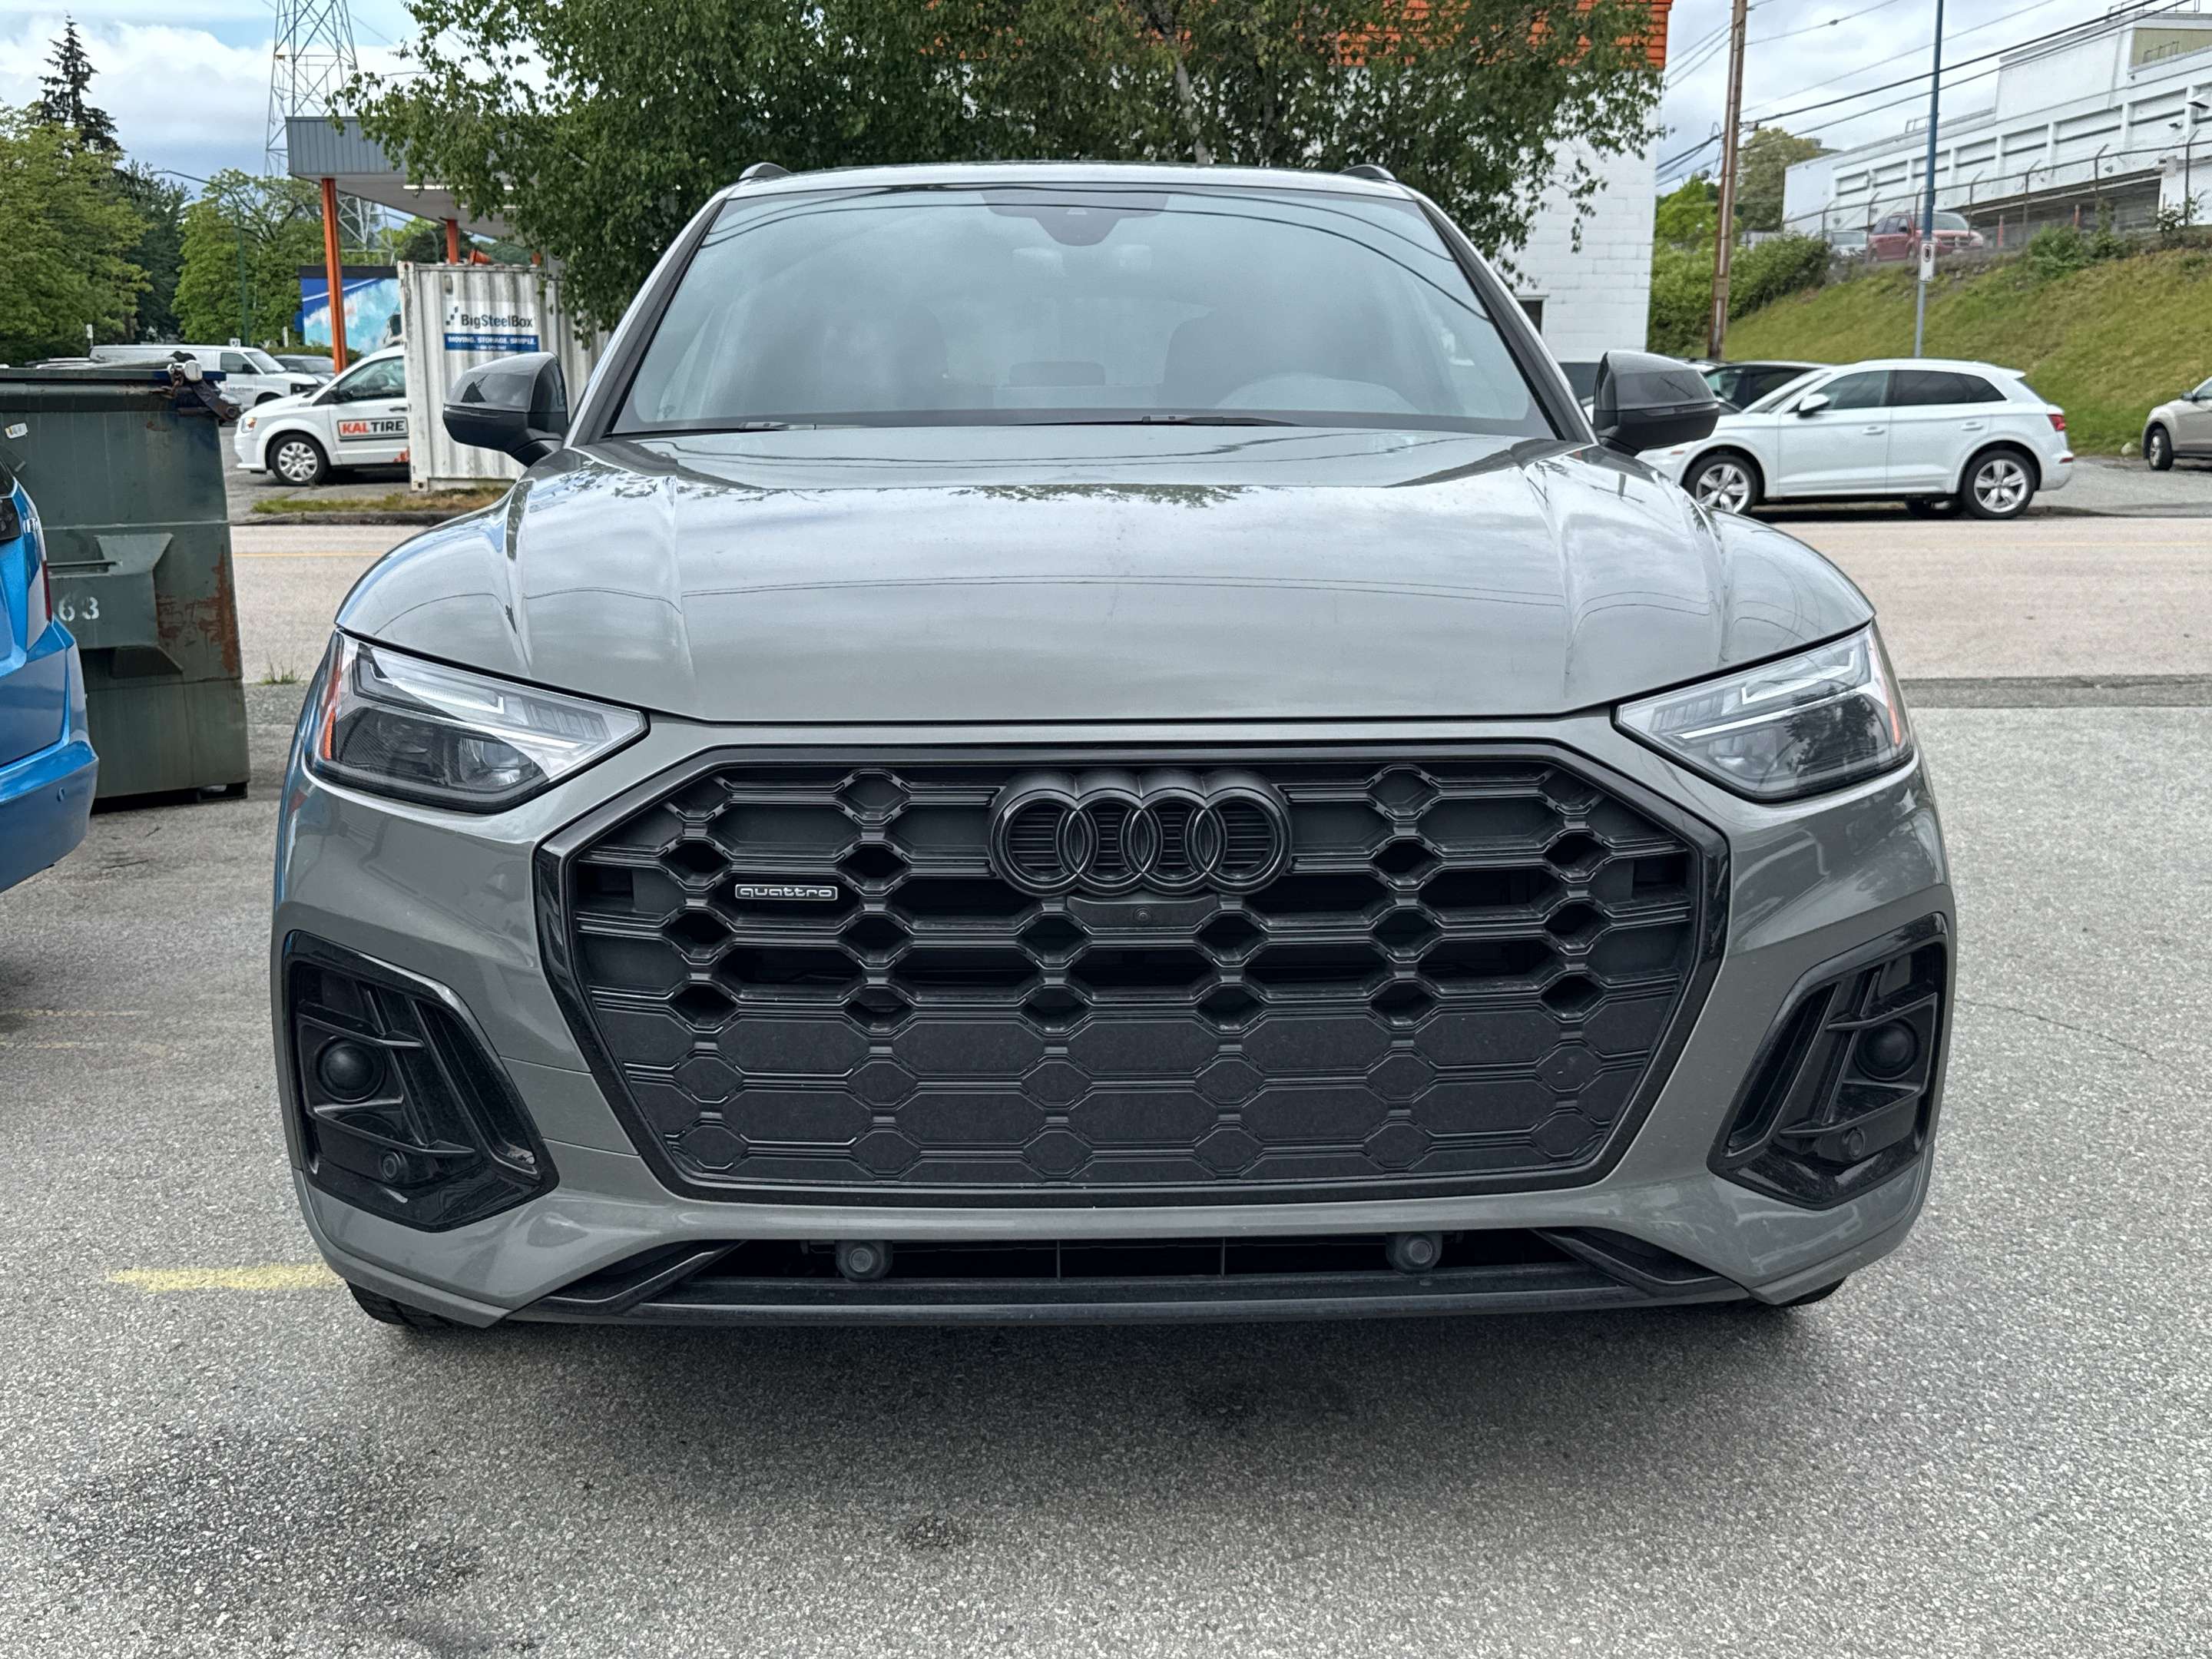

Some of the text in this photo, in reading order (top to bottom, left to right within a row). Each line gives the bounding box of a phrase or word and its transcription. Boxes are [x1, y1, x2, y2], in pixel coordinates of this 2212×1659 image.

[461, 314, 533, 329] BigSteelBox
[343, 420, 405, 434] KAL TIRE
[740, 887, 833, 898] quattro
